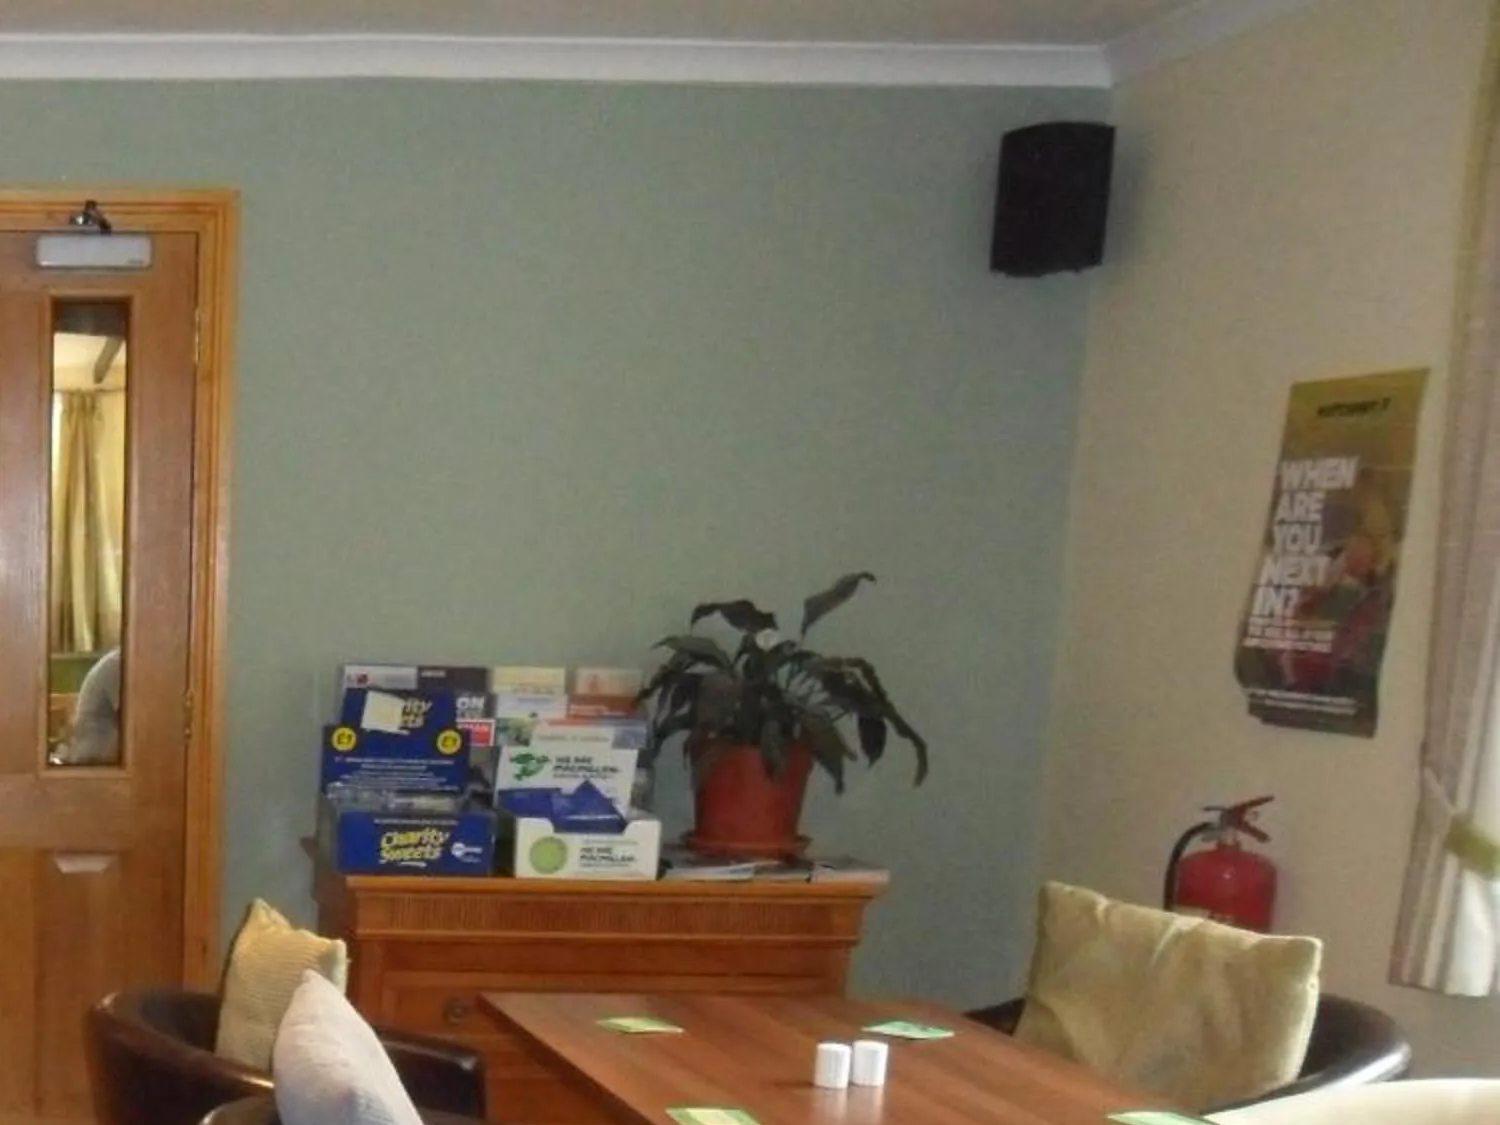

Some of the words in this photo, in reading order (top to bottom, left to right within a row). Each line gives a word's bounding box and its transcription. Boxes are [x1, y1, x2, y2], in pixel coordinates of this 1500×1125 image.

[1280, 456, 1359, 490] WHEN
[1276, 492, 1325, 521] ARE
[1273, 524, 1322, 556] YOU
[1260, 556, 1331, 587] NEXT
